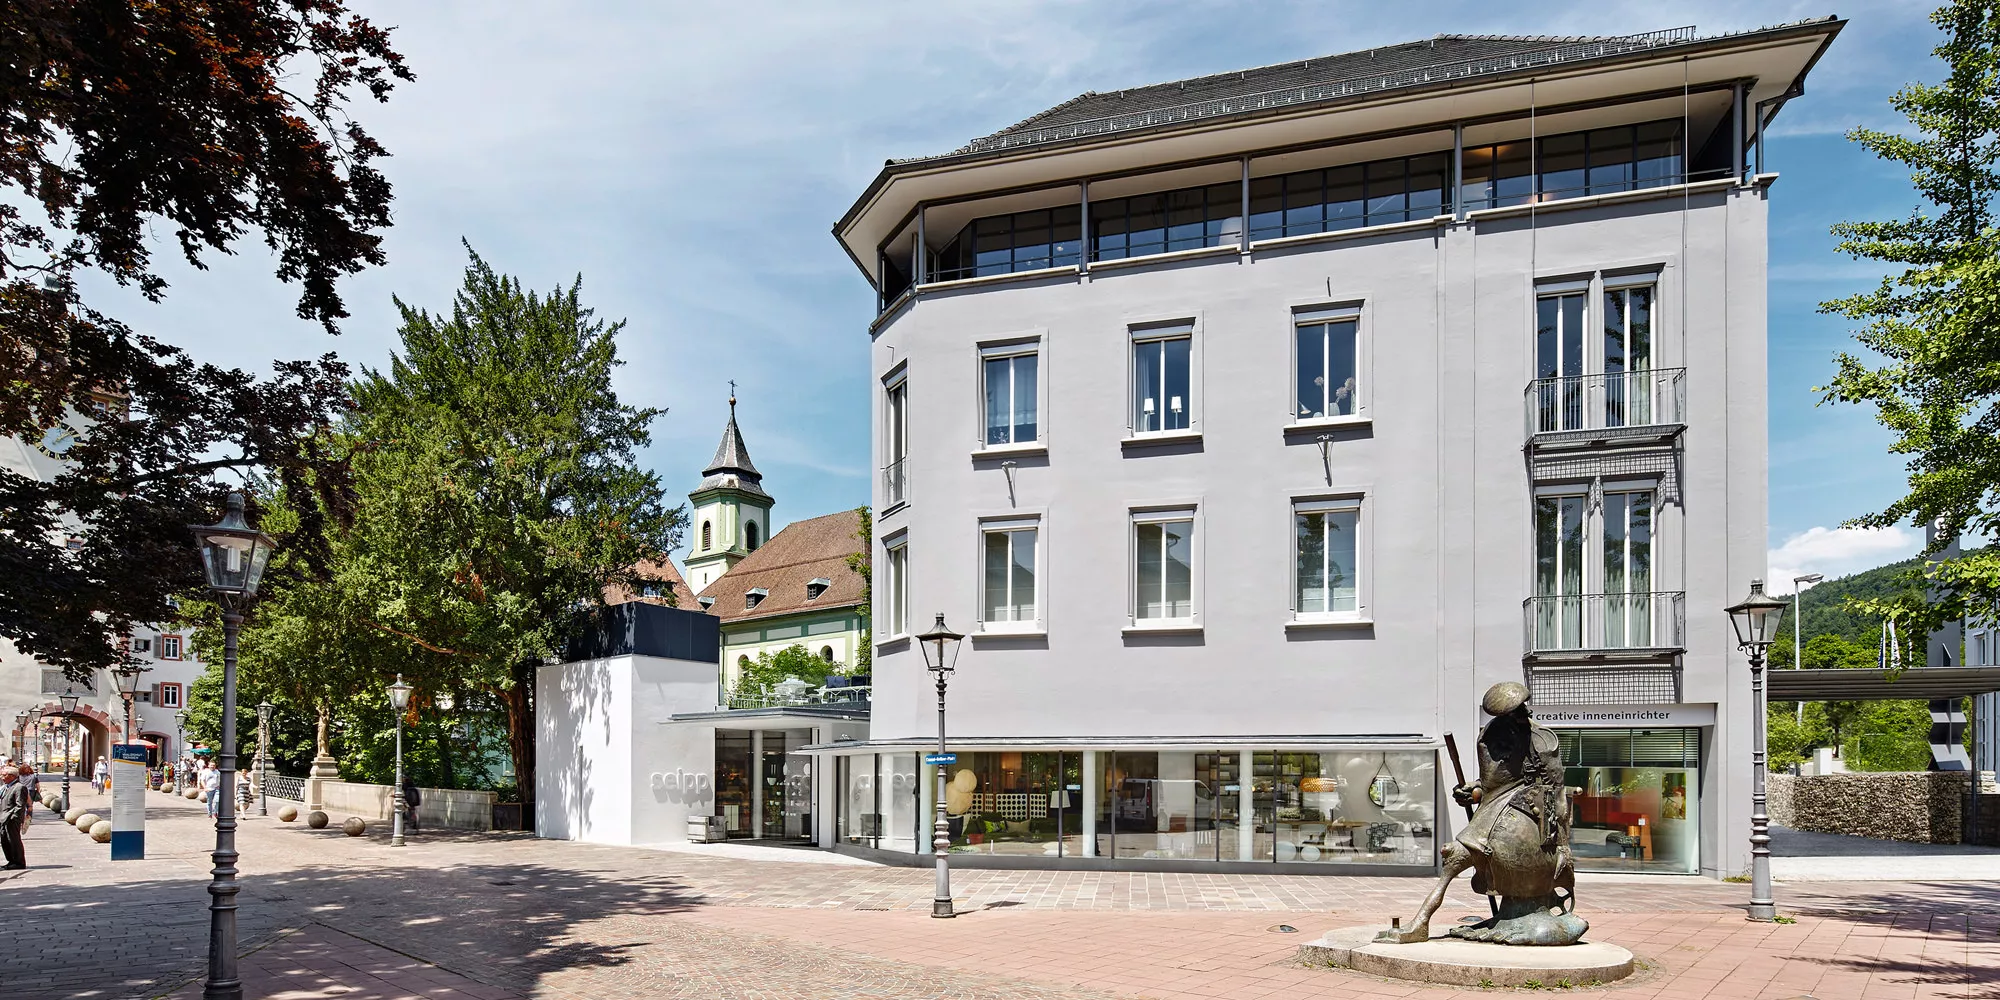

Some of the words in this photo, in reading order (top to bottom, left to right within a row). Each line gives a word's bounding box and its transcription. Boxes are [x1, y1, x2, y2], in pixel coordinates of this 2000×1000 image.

[1536, 711, 1580, 721] creative
[1583, 710, 1670, 721] inneneinrichter
[650, 768, 709, 794] seipp
